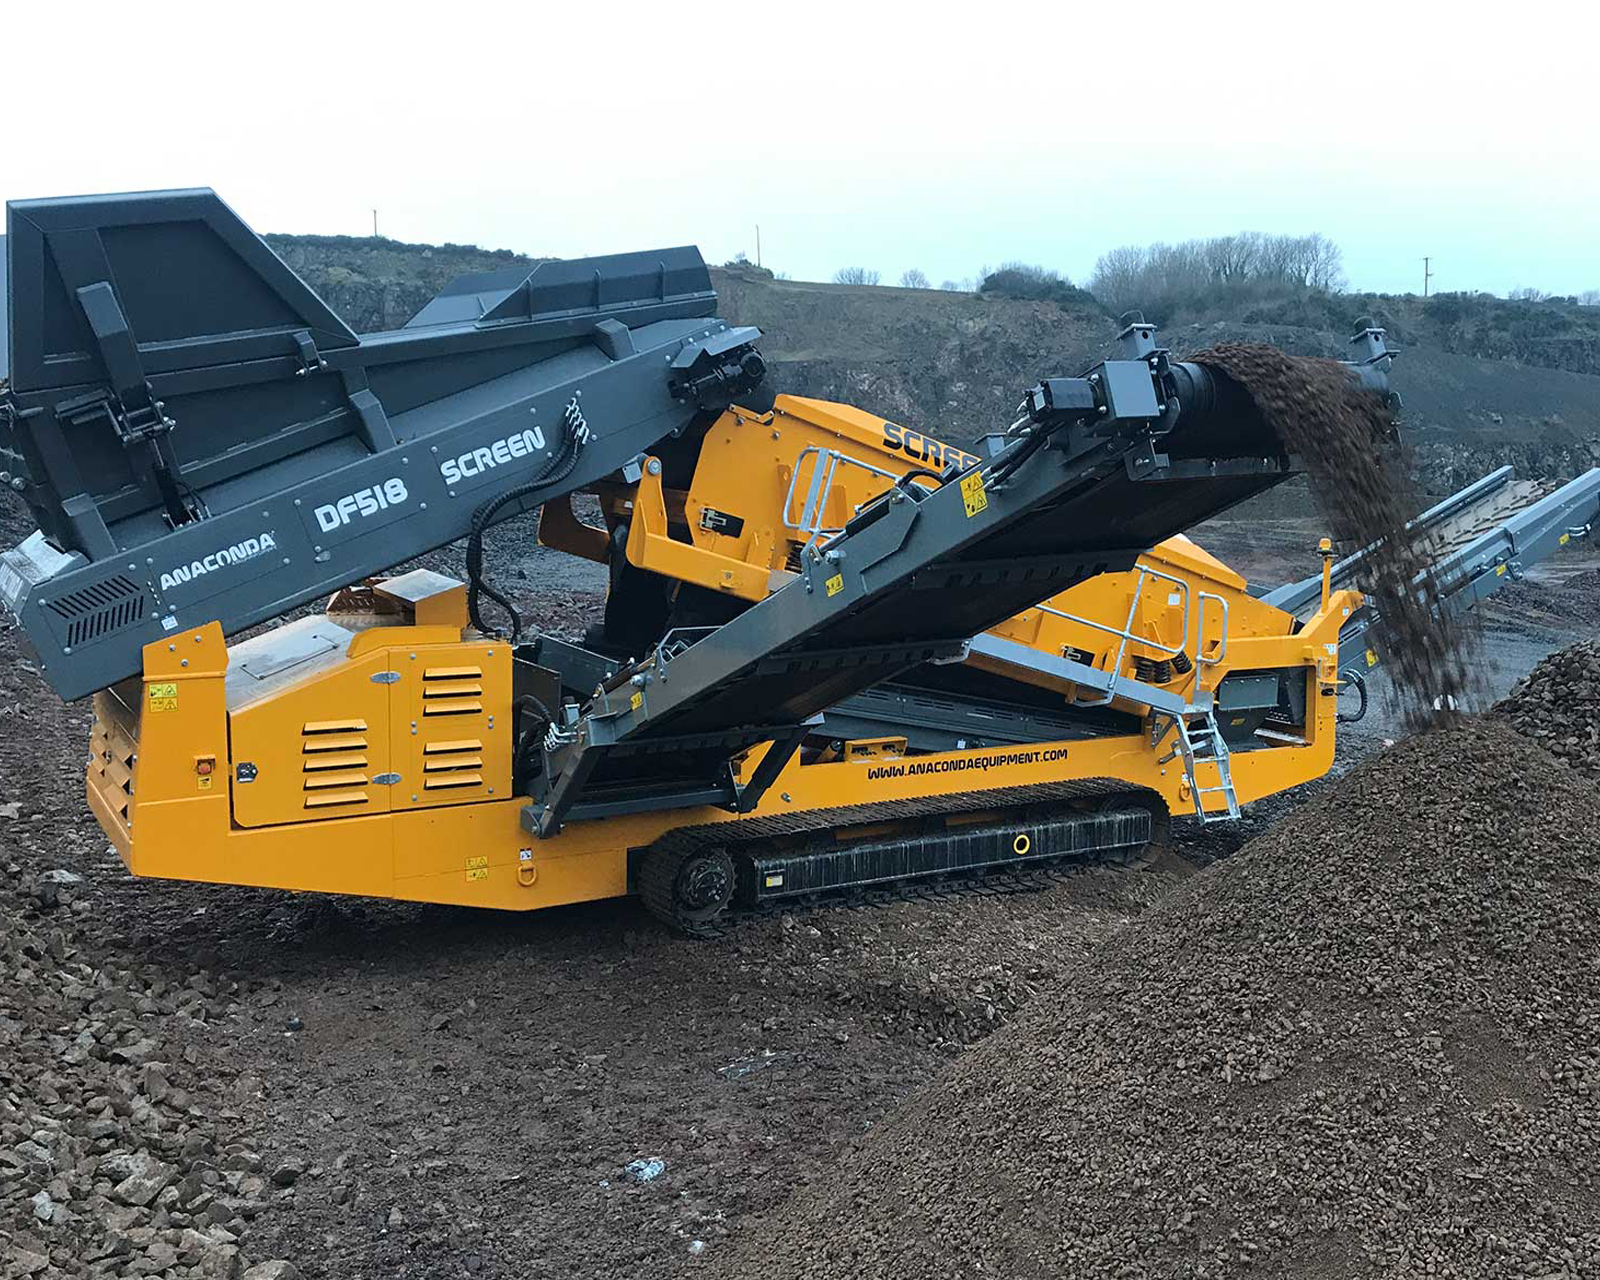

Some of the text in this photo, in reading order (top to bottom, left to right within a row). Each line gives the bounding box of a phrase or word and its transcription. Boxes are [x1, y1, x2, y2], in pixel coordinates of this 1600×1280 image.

[160, 426, 546, 591] ANACONDA DF518 SCREEN
[868, 749, 1068, 780] WWW.ANACONDAEQUIPMENT.COM
